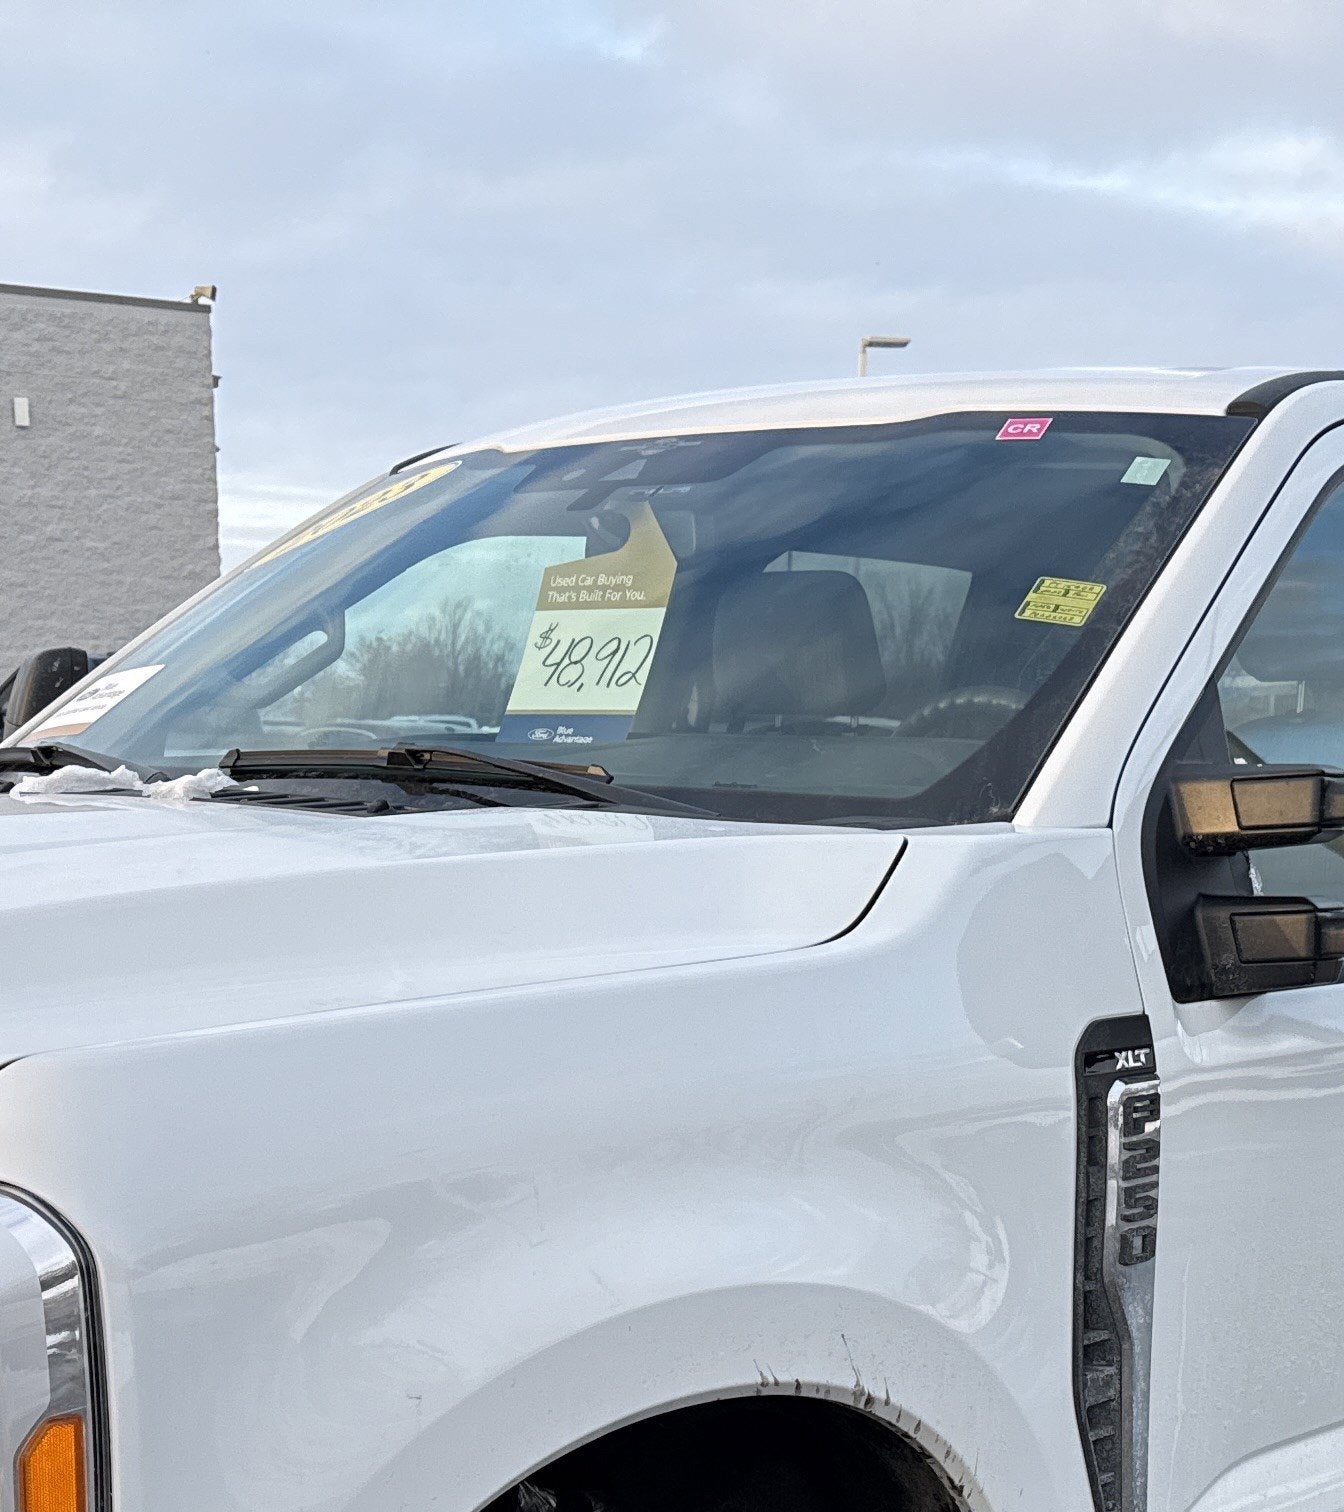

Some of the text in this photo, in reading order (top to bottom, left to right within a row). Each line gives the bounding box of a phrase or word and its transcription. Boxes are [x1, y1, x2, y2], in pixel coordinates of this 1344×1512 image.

[1007, 424, 1041, 434] CR
[550, 573, 634, 588] Used Car Buying
[547, 588, 646, 602] That's Built For You.
[1114, 1049, 1150, 1070] XLT
